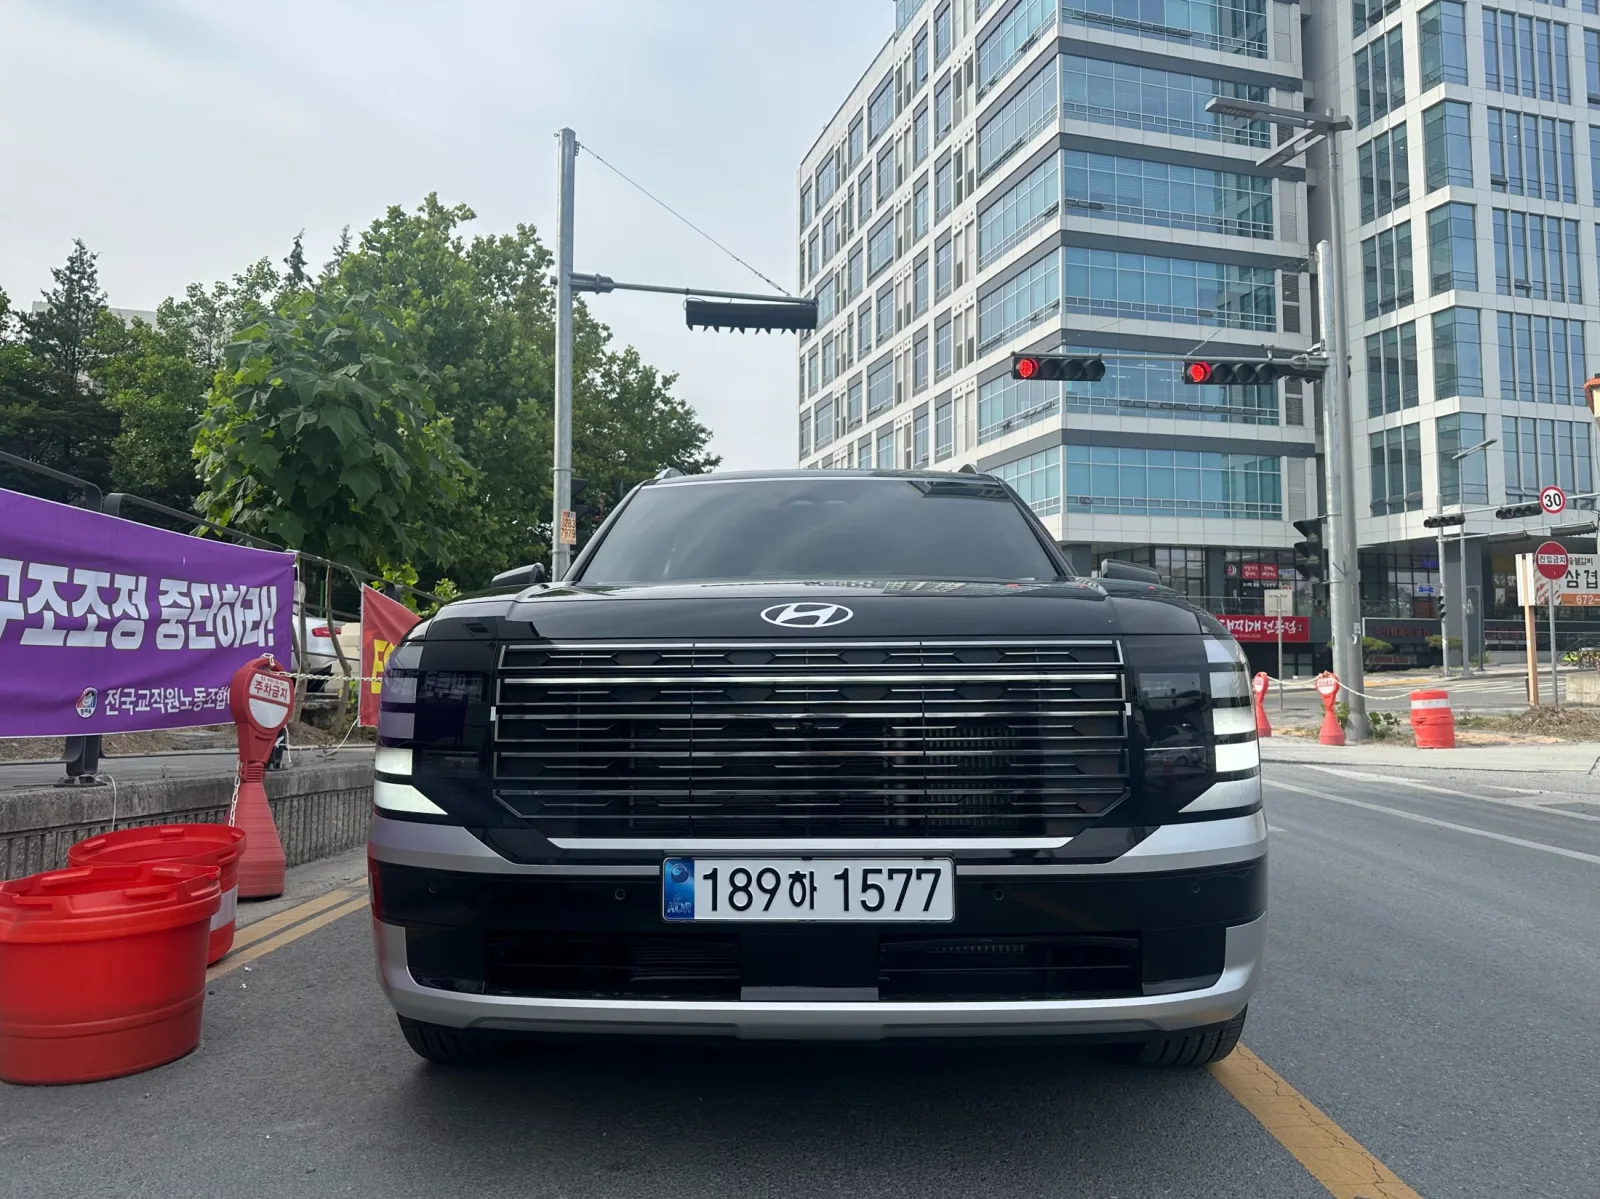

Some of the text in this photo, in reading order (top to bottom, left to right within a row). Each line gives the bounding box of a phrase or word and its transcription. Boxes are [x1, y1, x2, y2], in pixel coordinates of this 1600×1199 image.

[1544, 493, 1562, 508] 30
[1539, 555, 1566, 564] 진입금지
[1565, 569, 1598, 589] 삼겹
[155, 578, 277, 650] 중단하라!
[254, 680, 288, 701] 주차금지
[702, 867, 942, 912] 189하 1577
[667, 901, 692, 914] KOR
